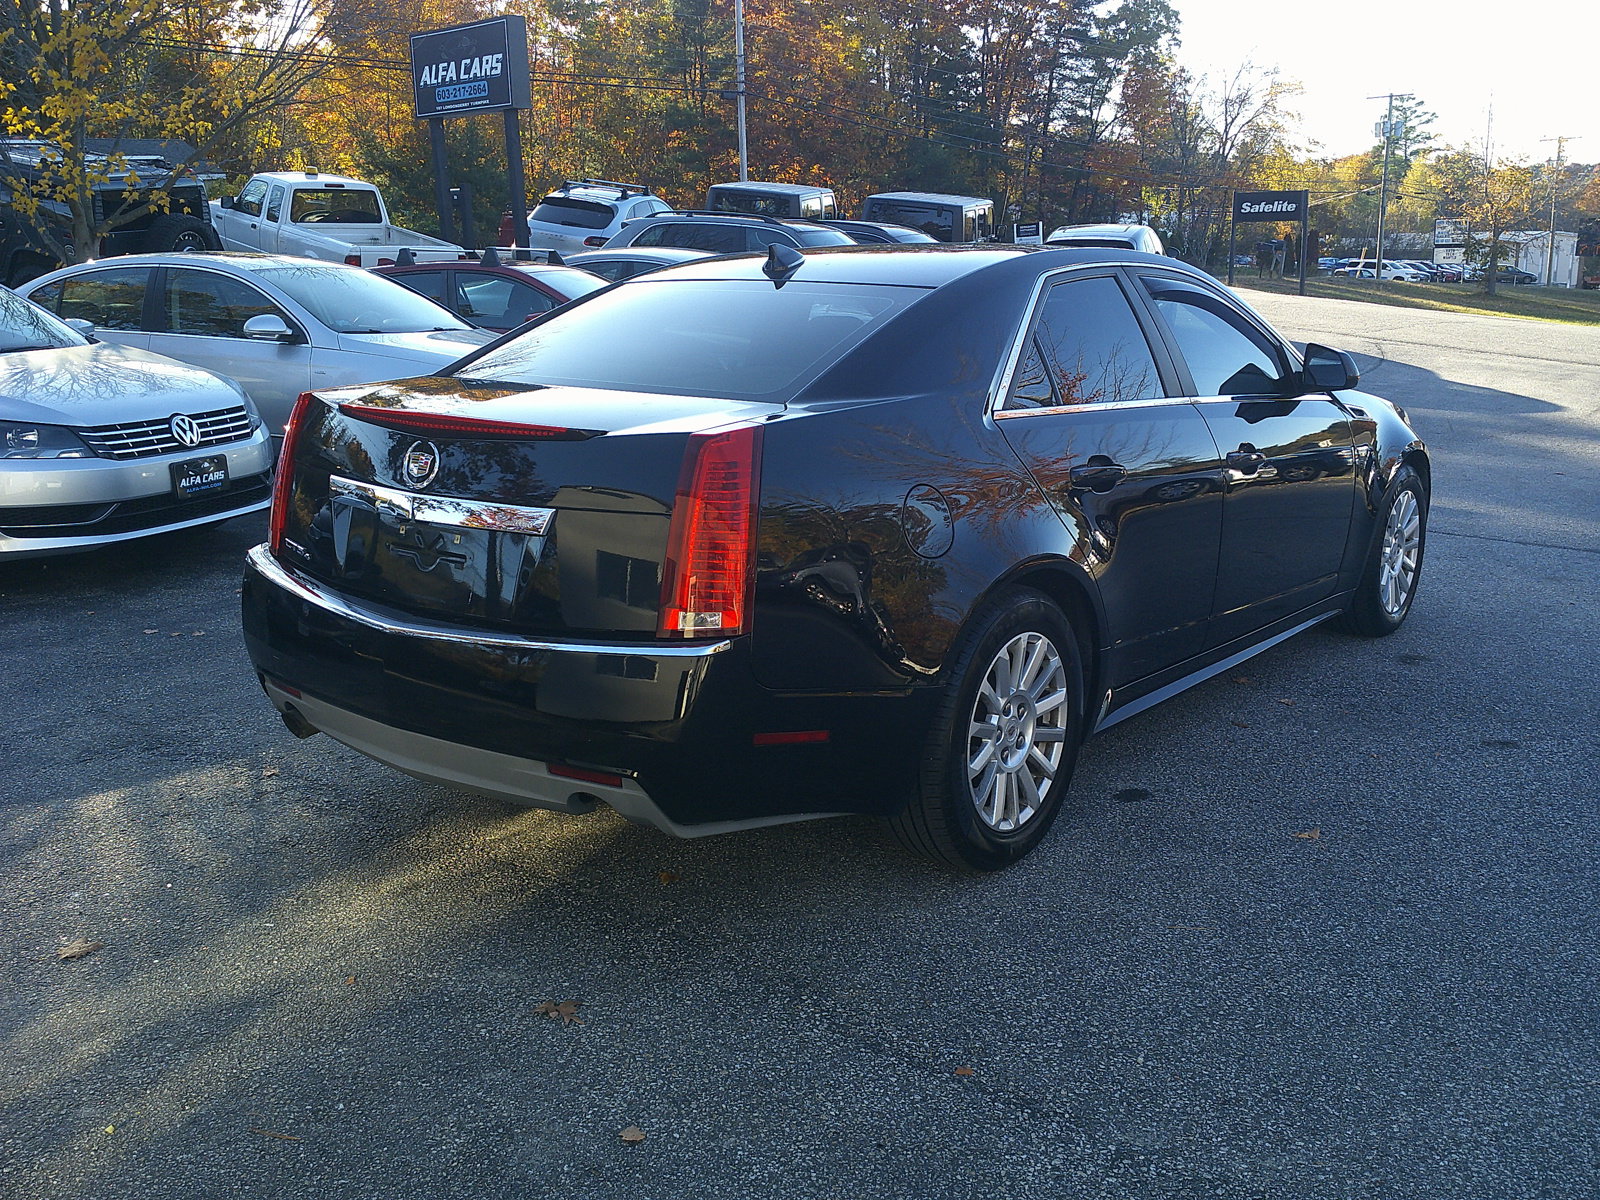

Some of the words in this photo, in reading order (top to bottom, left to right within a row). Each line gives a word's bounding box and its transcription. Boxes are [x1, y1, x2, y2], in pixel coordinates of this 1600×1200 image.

[420, 61, 457, 86] ALFA
[460, 53, 503, 80] CARS
[436, 83, 487, 101] 603-217-2664
[1241, 200, 1296, 213] Safelite
[180, 475, 201, 488] ALFA
[202, 470, 225, 483] CARS
